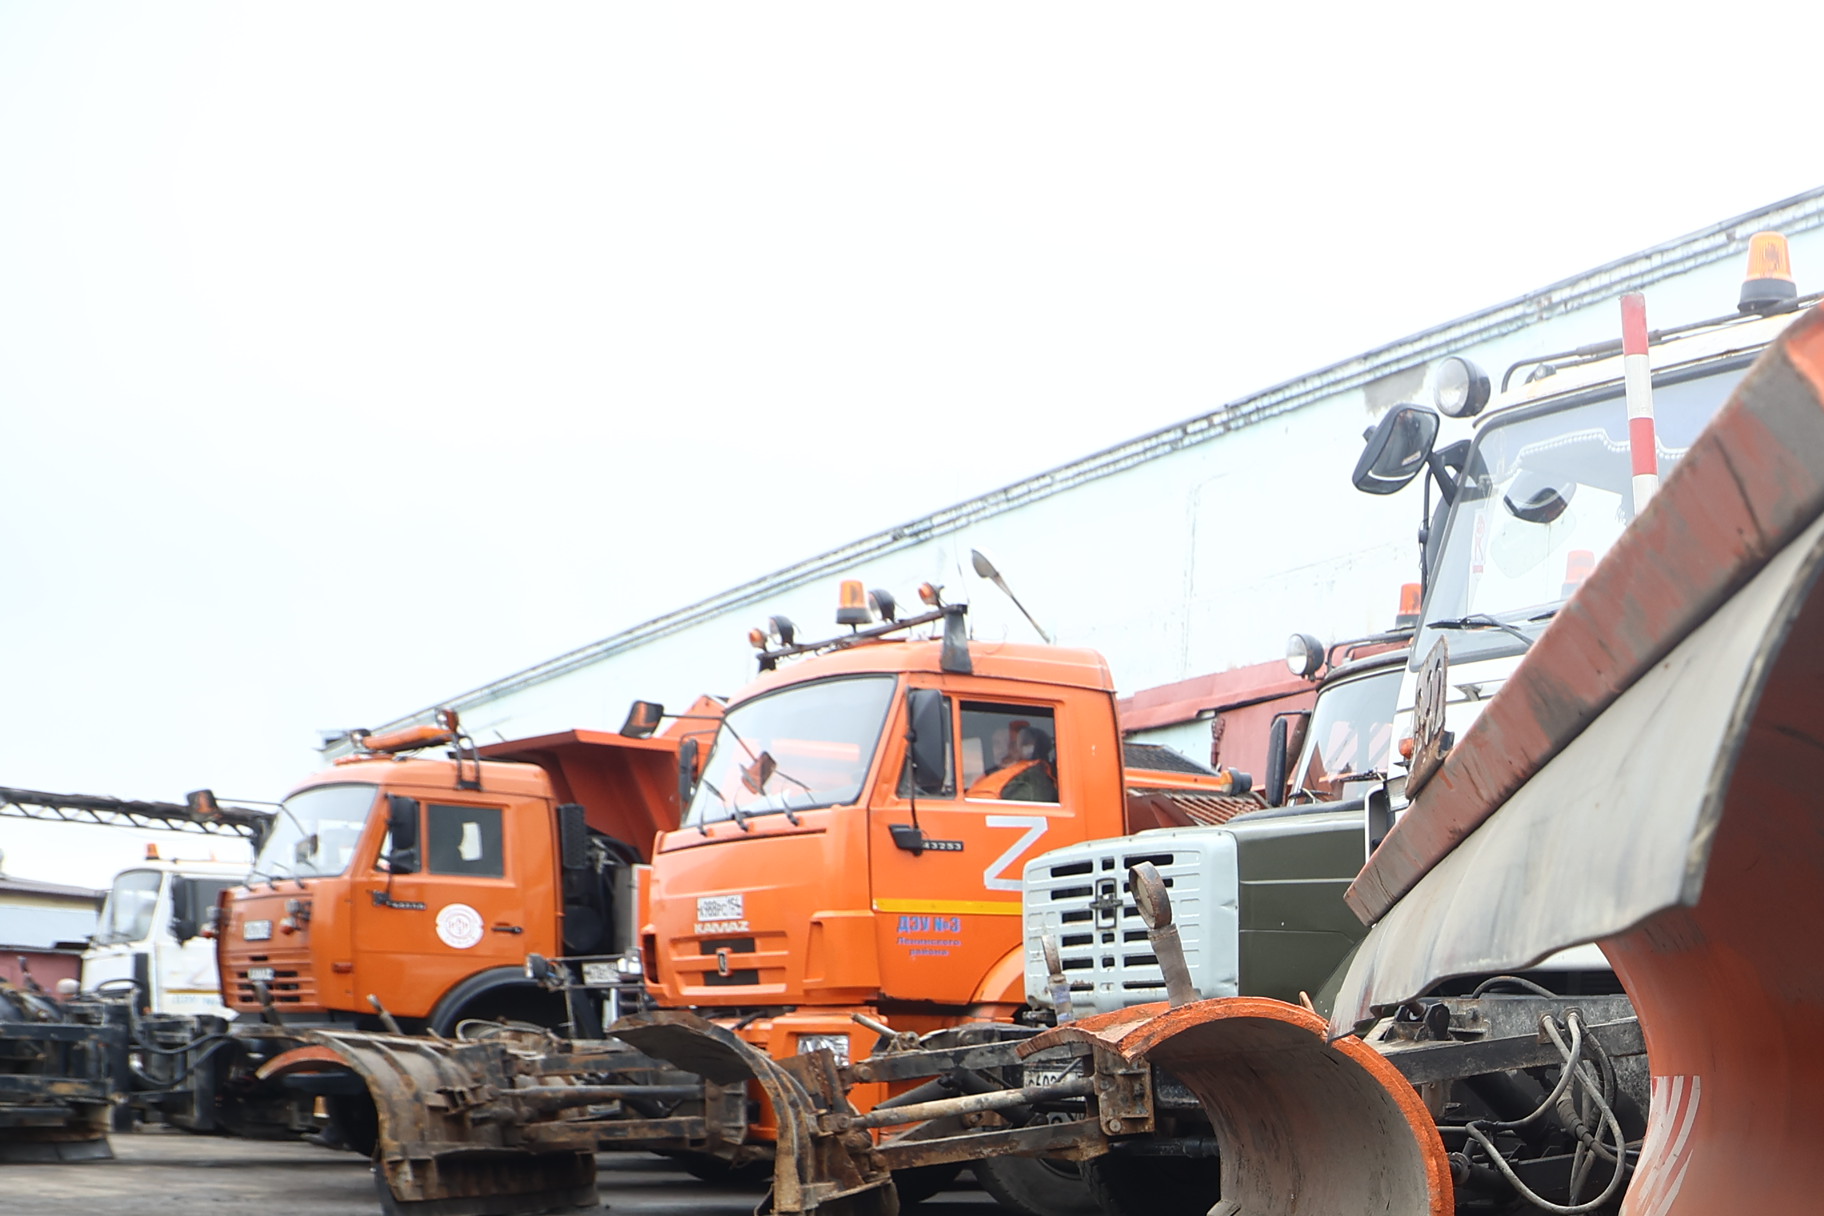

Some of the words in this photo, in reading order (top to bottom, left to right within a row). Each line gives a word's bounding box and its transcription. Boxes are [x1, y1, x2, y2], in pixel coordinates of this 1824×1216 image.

[984, 815, 1049, 891] Z
[898, 916, 929, 933] ДЭУ
[933, 917, 961, 932] №3
